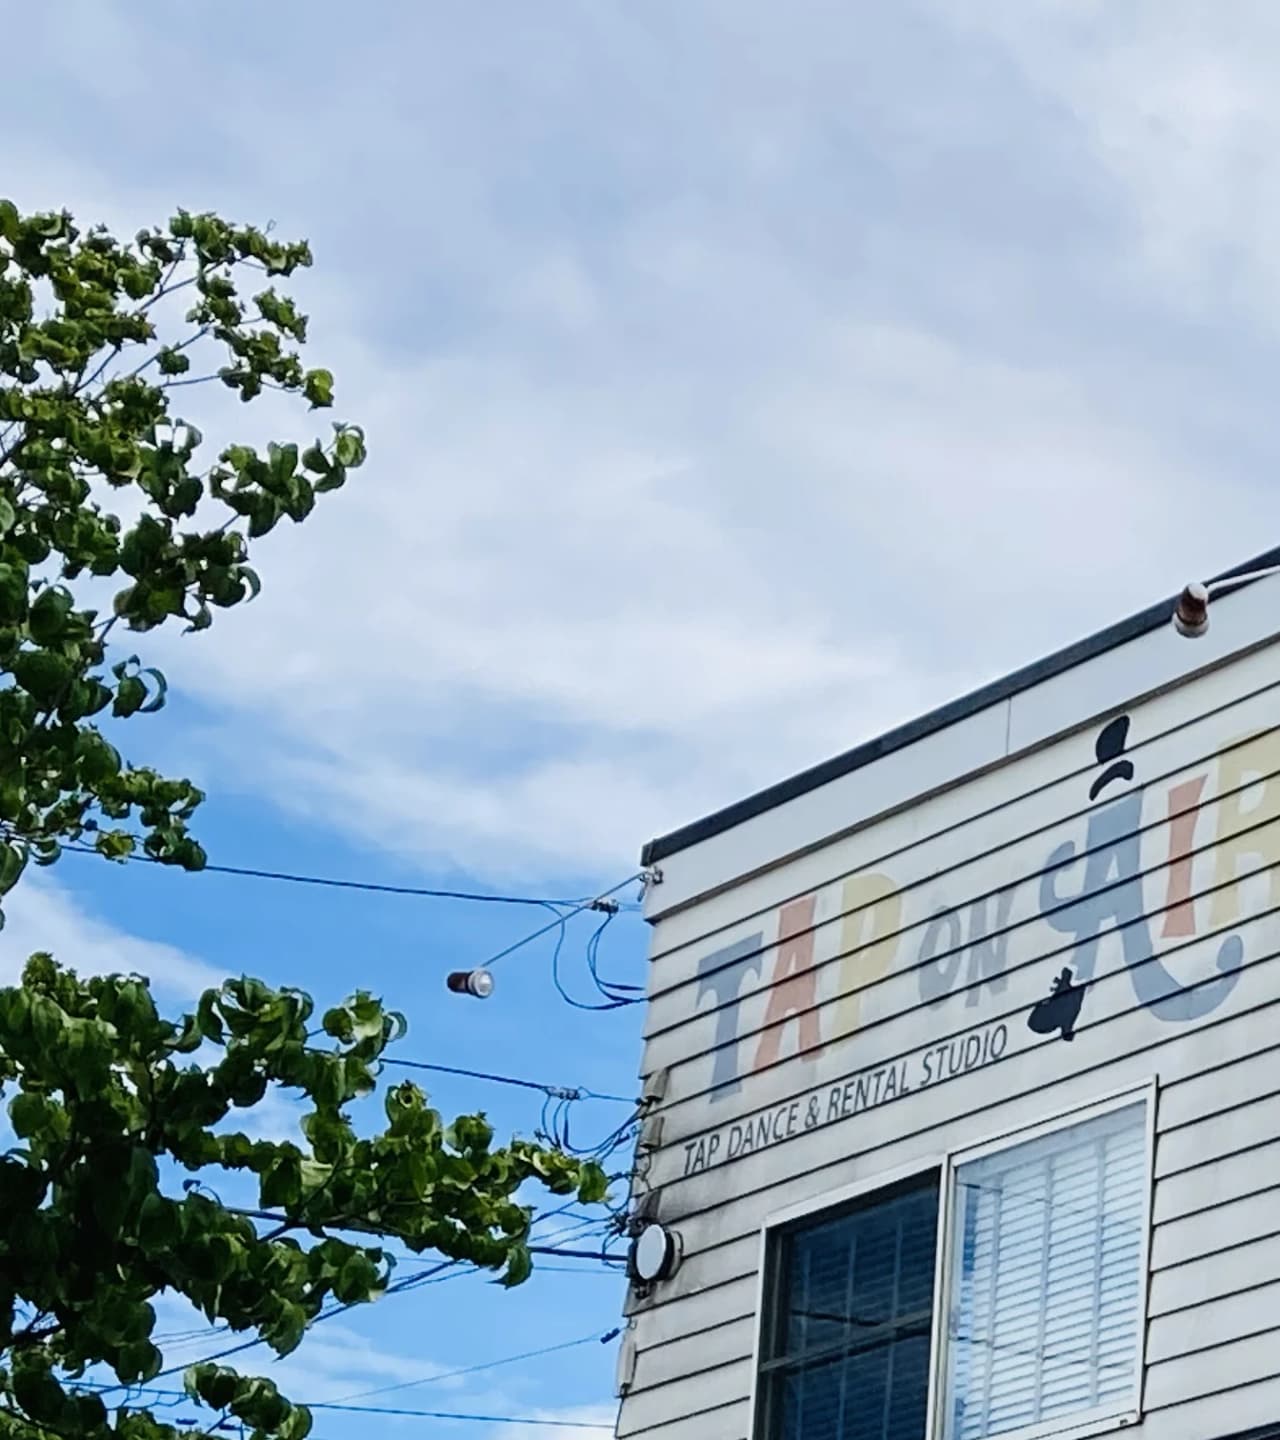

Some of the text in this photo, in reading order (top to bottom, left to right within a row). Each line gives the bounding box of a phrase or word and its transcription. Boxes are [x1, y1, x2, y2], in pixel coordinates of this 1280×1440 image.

[696, 872, 905, 1105] TAP
[916, 880, 1017, 1011] ON
[682, 1024, 1009, 1177] TAP DANCE & RENTAL STUDIO
